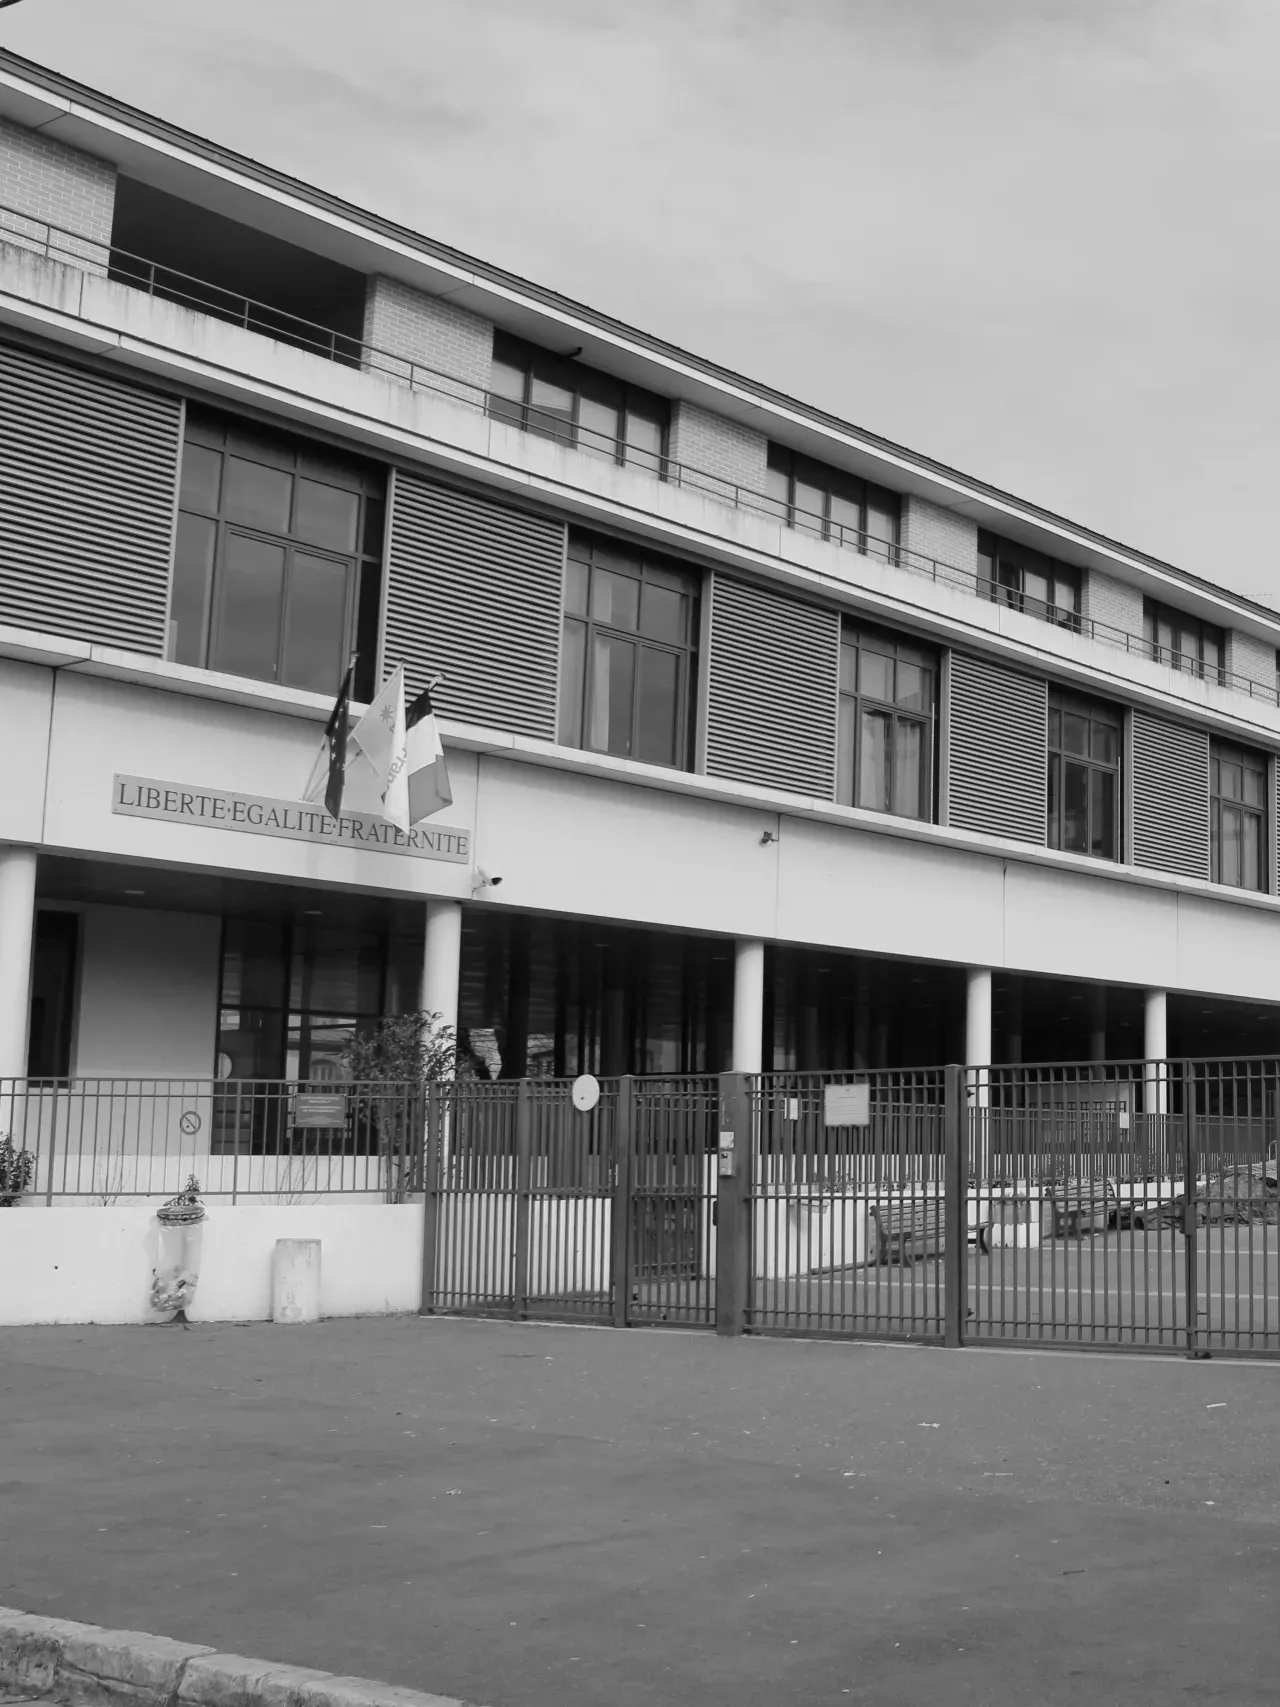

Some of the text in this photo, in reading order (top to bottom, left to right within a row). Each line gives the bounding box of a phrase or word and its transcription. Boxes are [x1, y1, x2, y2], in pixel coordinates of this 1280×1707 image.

[118, 783, 468, 856] LIBERTE EGALITE FRATERNITE
